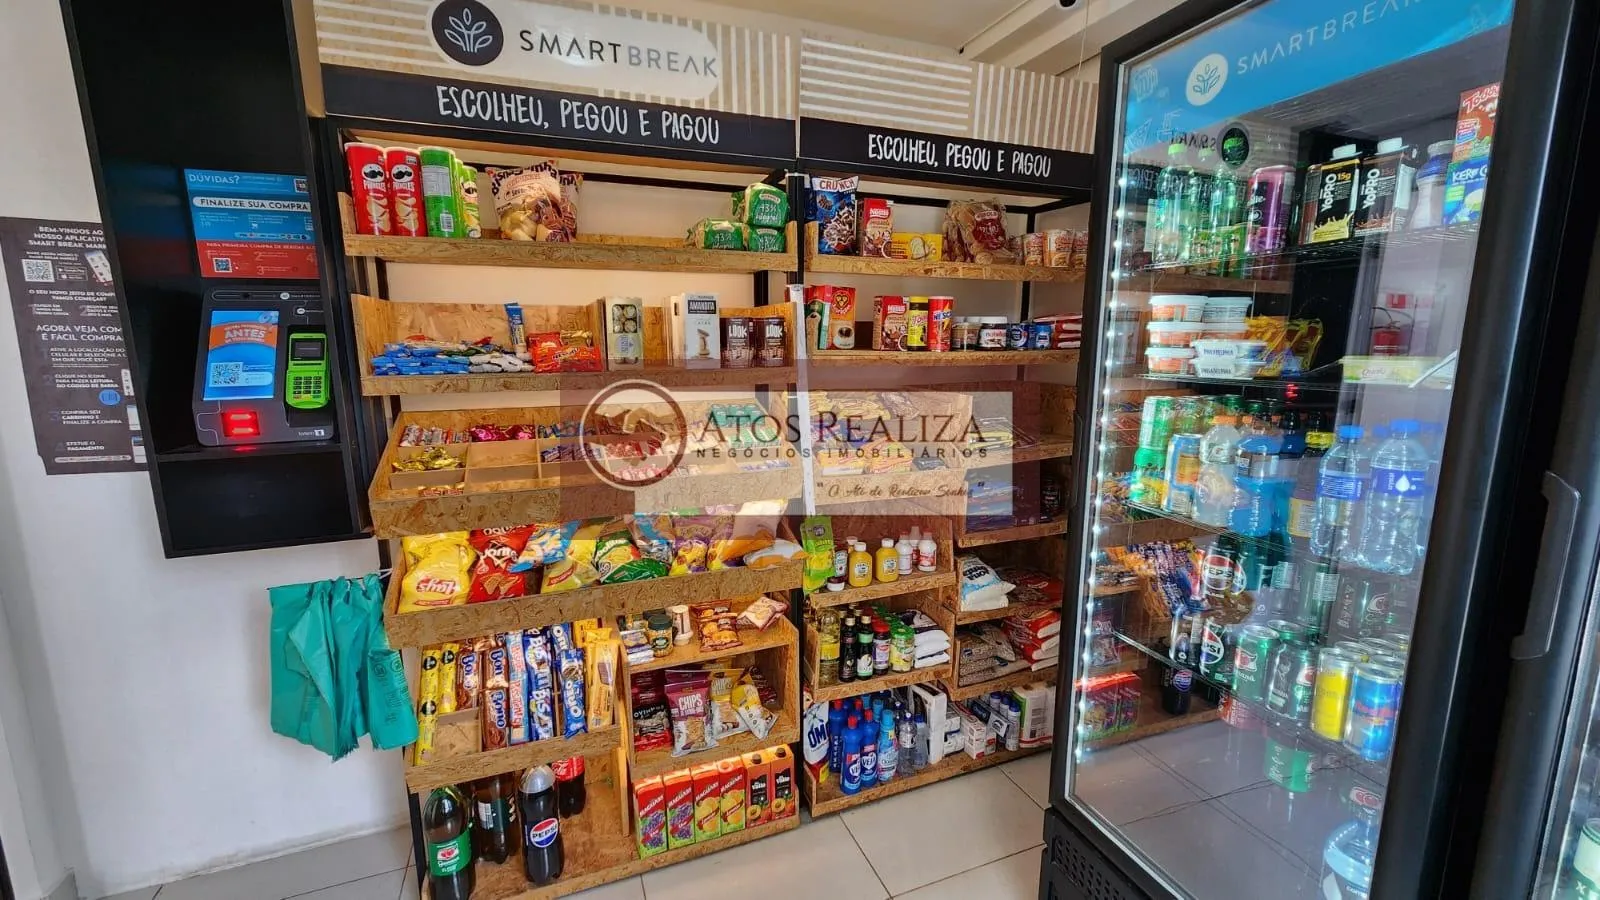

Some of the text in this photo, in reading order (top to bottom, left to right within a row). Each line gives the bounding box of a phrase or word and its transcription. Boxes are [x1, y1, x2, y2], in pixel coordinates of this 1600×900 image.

[519, 29, 718, 78] SMARTBREAK
[437, 84, 721, 146] ESCOLHEU, PEGOU E PAGOU
[868, 132, 1052, 178] ESCOLHEU, PEGOU E PAGOU
[820, 178, 855, 192] CRUNCH
[200, 198, 309, 211] FINALIZE SUA COMPRA
[34, 232, 62, 240] NOSSO
[39, 226, 90, 235] BEM-VINDOS
[36, 324, 72, 332] AGORA
[74, 325, 97, 333] VEJA
[224, 328, 266, 339] ANTES
[728, 324, 748, 339] LOOK
[765, 324, 783, 338] LOOK
[490, 689, 507, 729] Bono
[678, 693, 704, 711] CHIPS
[532, 824, 558, 840] PEPSI
